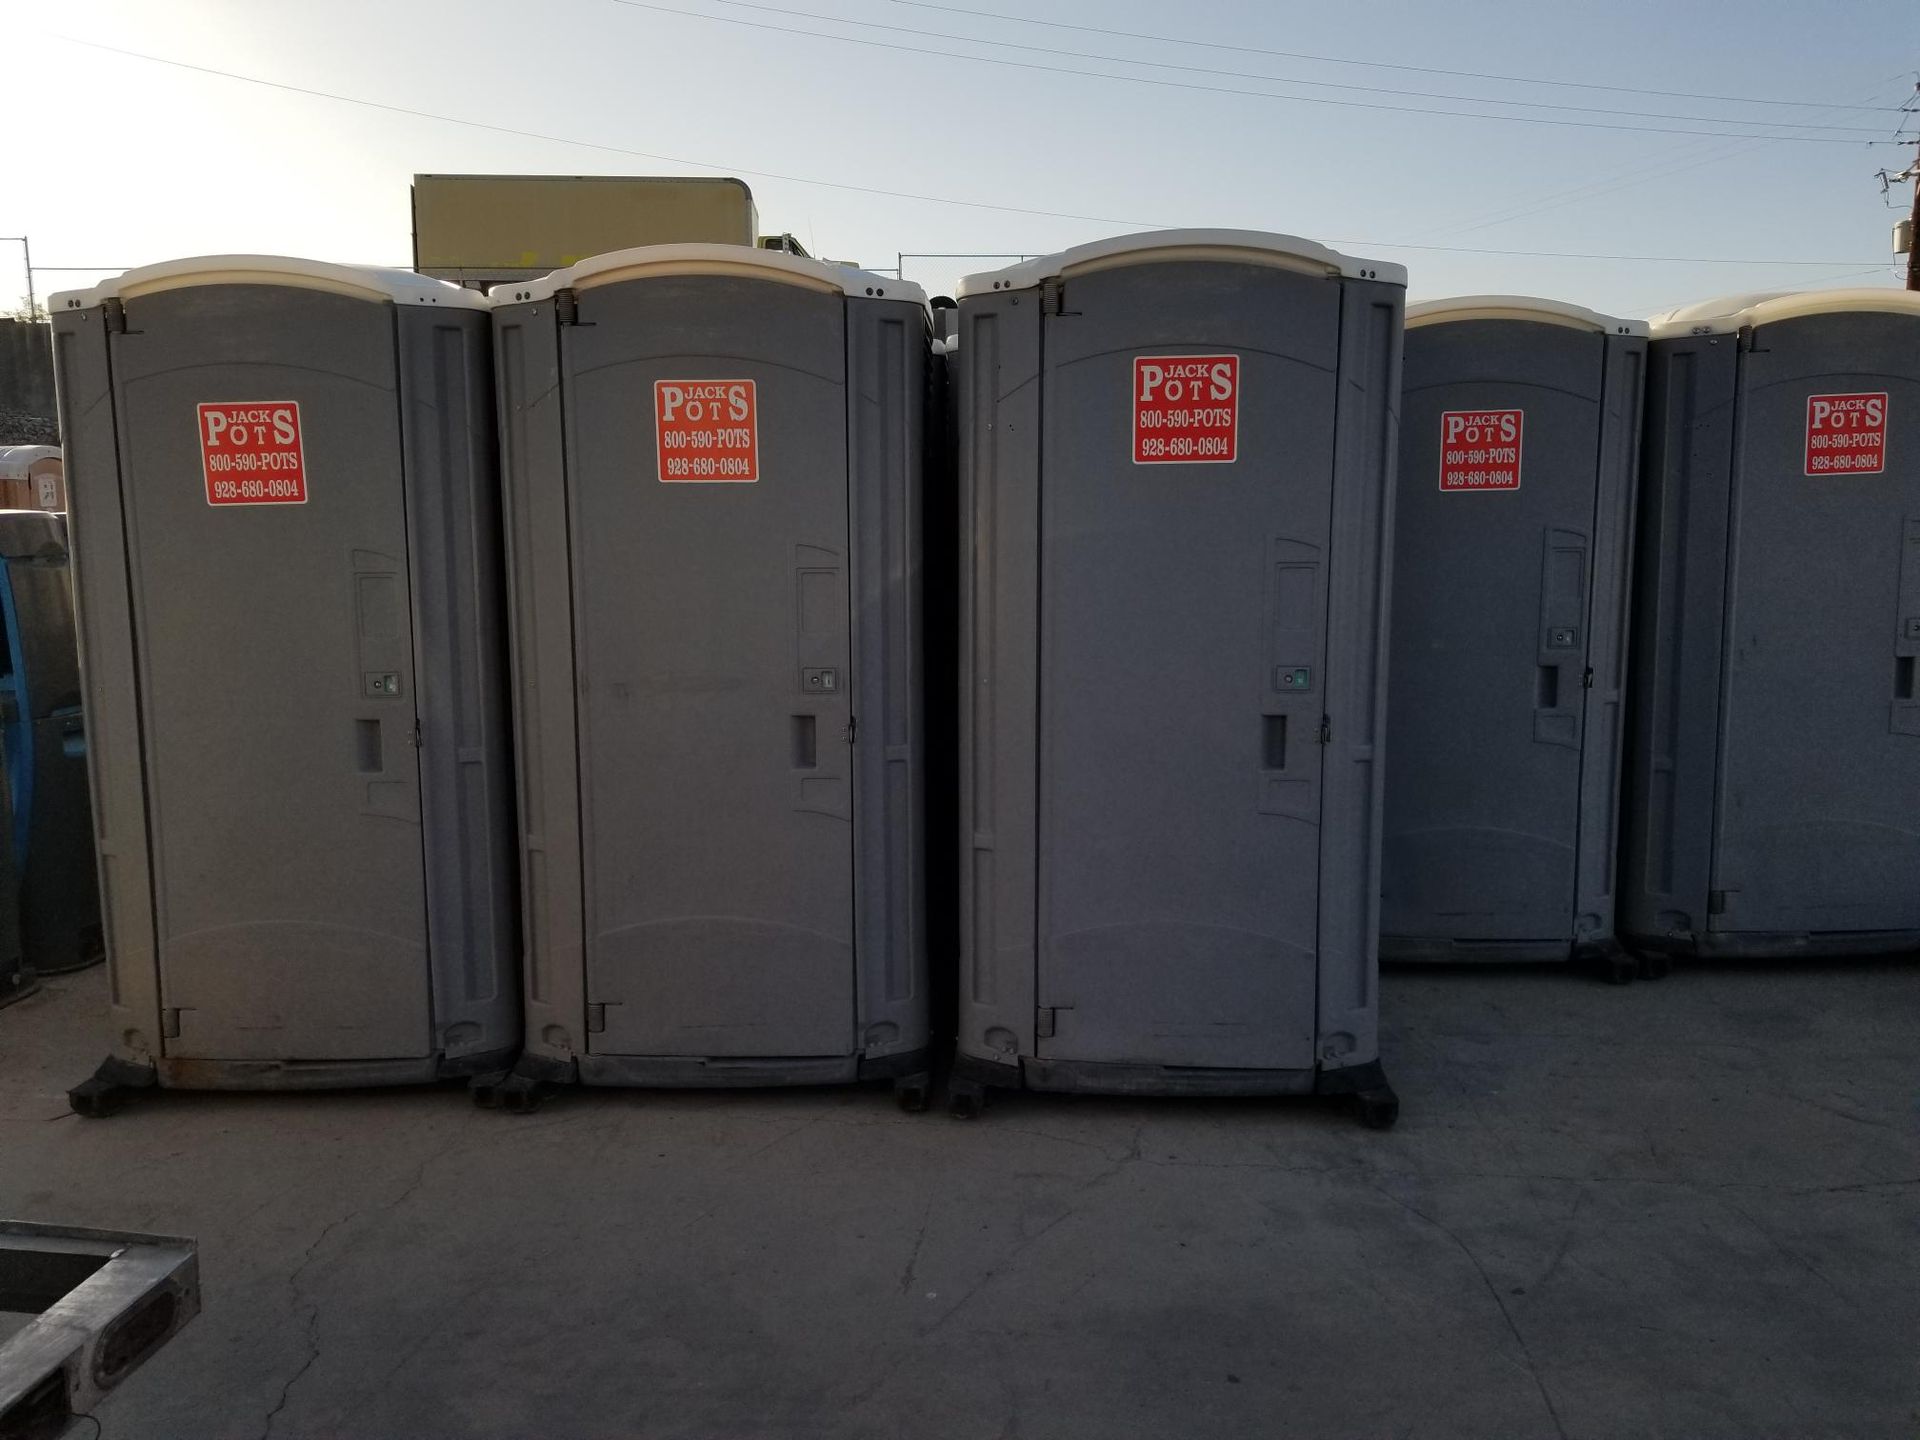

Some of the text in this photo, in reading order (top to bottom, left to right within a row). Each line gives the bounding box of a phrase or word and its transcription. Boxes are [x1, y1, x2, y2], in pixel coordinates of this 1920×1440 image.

[1164, 364, 1210, 378] JACK
[1140, 363, 1232, 401] POTS
[685, 386, 727, 399] JACK
[661, 385, 749, 421] POTS
[1831, 400, 1866, 410] JACK
[228, 410, 272, 423] JACK
[1140, 408, 1232, 428] 800-590-POTS
[1465, 415, 1500, 426] JACK
[1812, 399, 1883, 428] POTS
[204, 409, 295, 446] POTS
[1446, 414, 1516, 443] POTS
[664, 428, 750, 448] 800-590-POTS
[1142, 437, 1228, 456] 928-680-0804
[1811, 432, 1881, 448] 800-590-POTS
[210, 452, 298, 471] 800-590-POTS
[1446, 447, 1516, 464] 800-590-POTS
[1812, 454, 1878, 469] 928-680-0804
[667, 457, 750, 475] 928-680-0804
[1447, 471, 1513, 485] 928-680-0804
[214, 479, 299, 498] 928-680-0804
